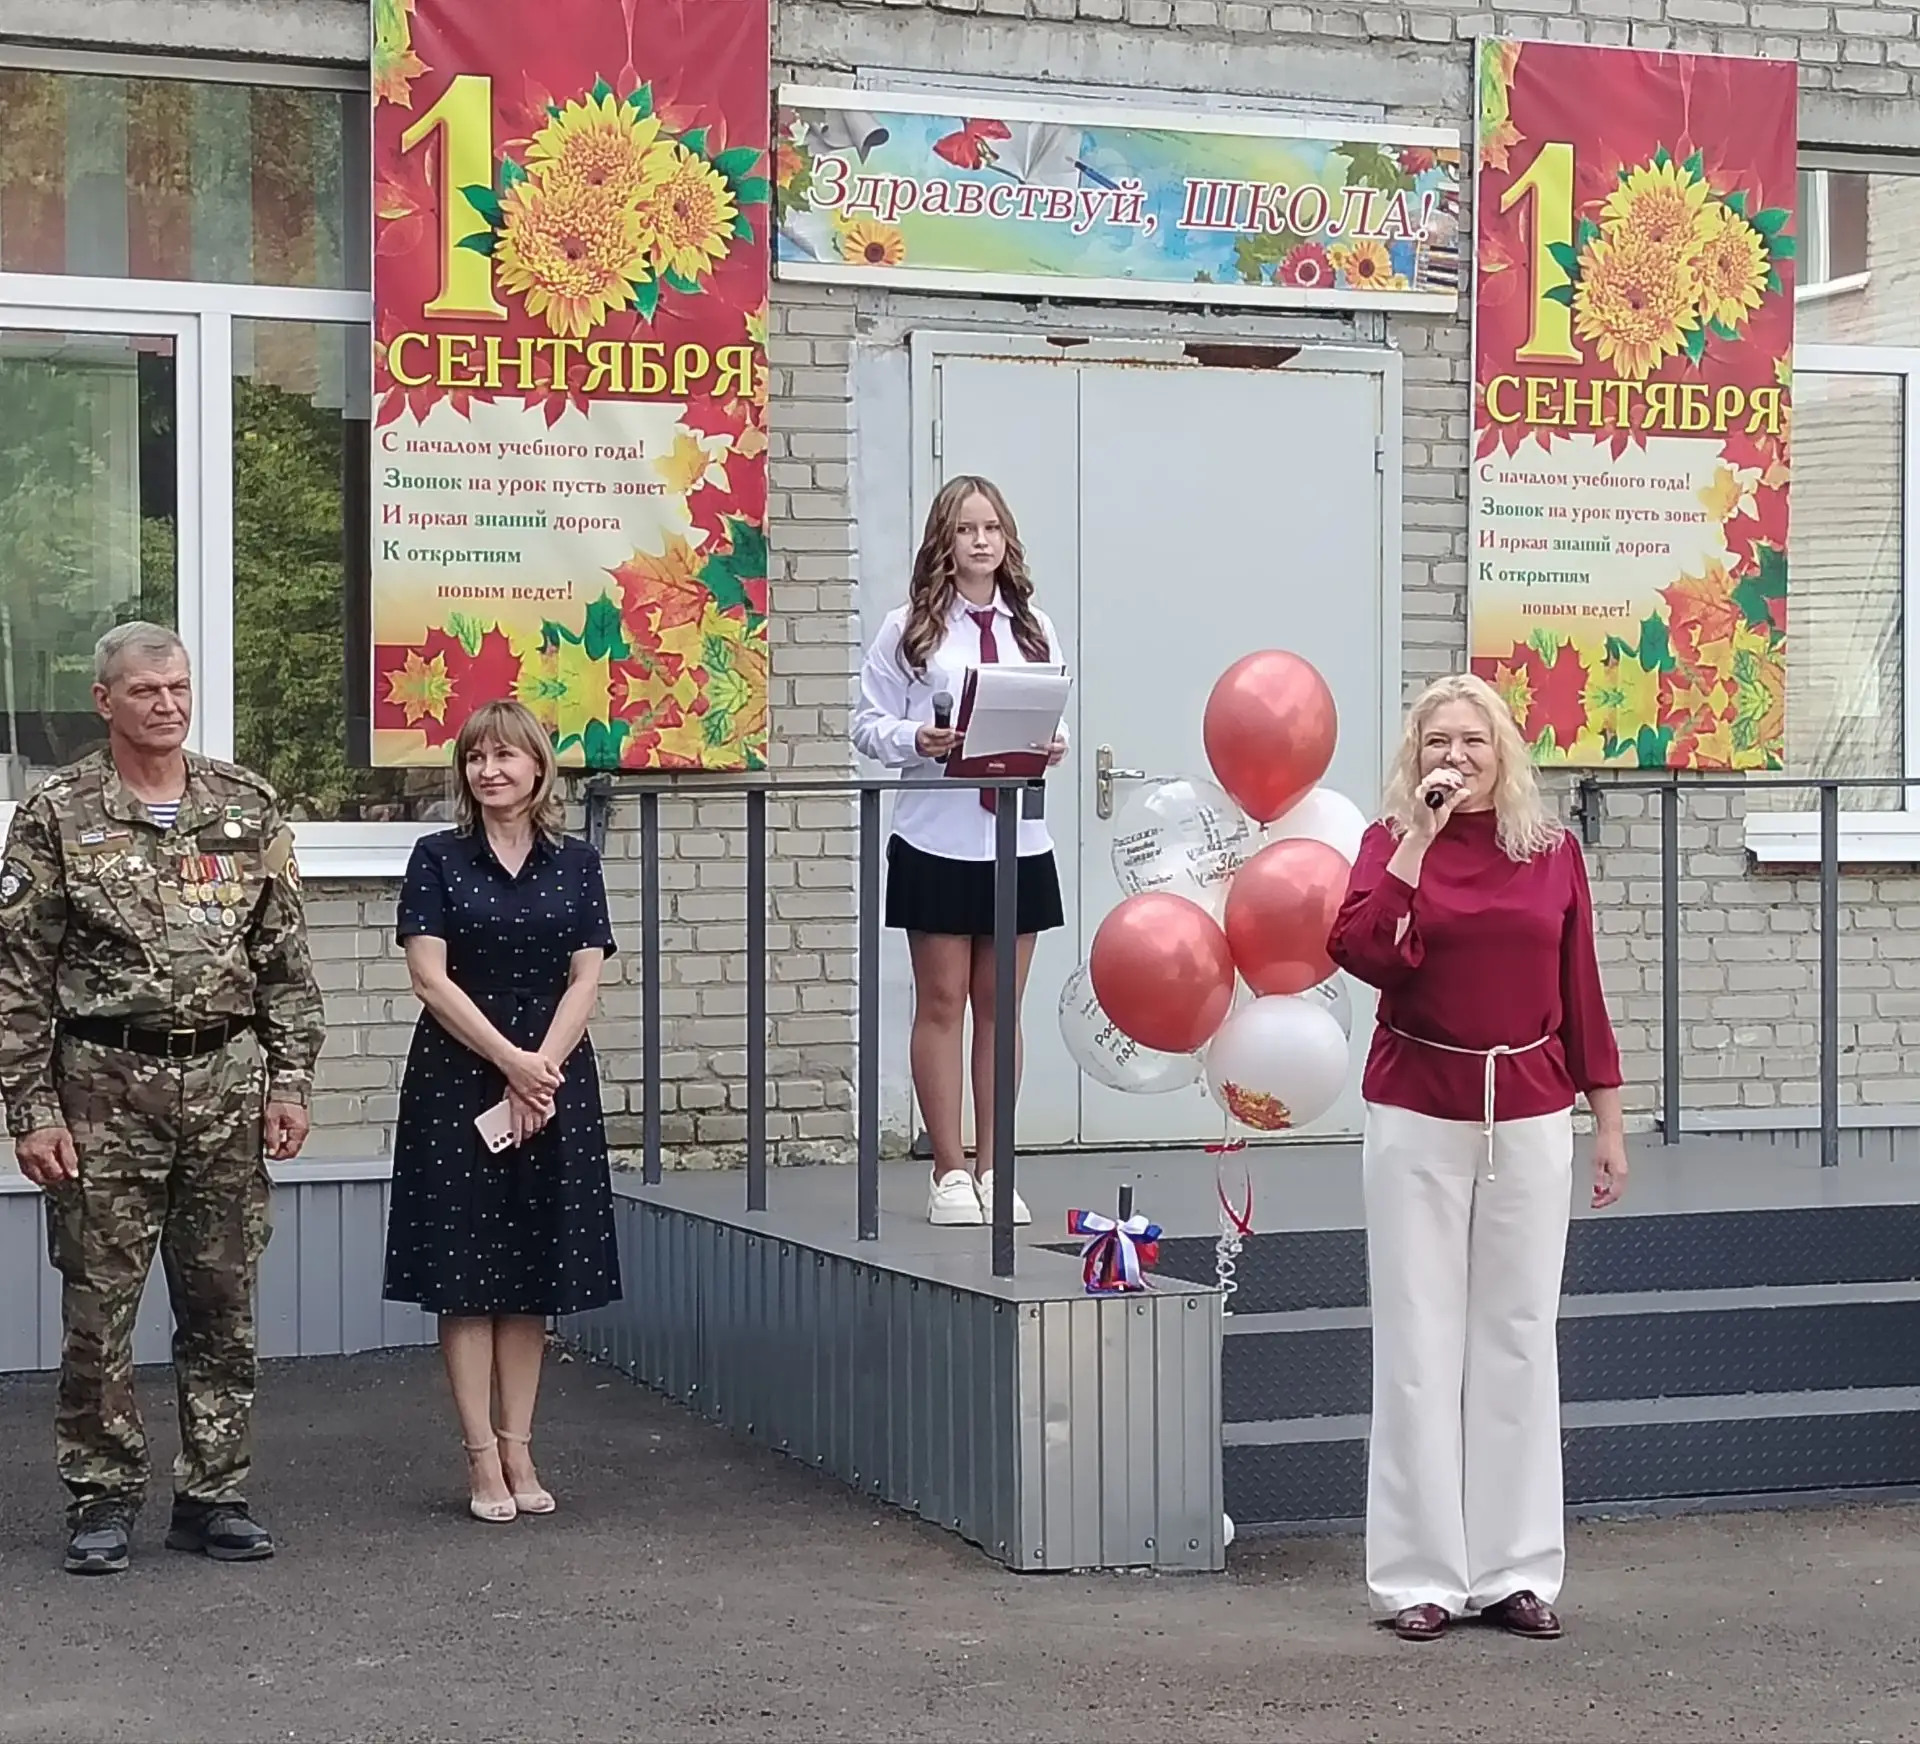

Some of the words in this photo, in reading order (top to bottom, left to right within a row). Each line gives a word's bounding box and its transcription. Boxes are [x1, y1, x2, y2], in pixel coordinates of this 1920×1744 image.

[401, 74, 508, 321] 1
[809, 156, 1157, 234] Здравствуй,
[1181, 180, 1436, 241] ШКОЛА!
[1500, 142, 1584, 364] 1
[388, 331, 754, 397] СЕНТЯБРЯ
[1486, 374, 1782, 434] СЕНТЯБРЯ
[381, 431, 398, 452] С
[406, 440, 491, 455] началом
[498, 439, 588, 460] учебного
[594, 440, 644, 459] года!
[383, 467, 462, 490] Звонок
[468, 477, 491, 490] на
[498, 478, 546, 495] урок
[552, 480, 606, 497] пусть
[612, 481, 666, 496] зовет
[1480, 464, 1494, 482] С
[1499, 471, 1568, 485] началом
[1572, 472, 1645, 490] учебного
[1650, 473, 1691, 491] года!
[381, 504, 401, 524] И
[408, 511, 468, 530] яркая
[474, 509, 547, 528] знаний
[553, 515, 621, 533] дорога
[1481, 497, 1544, 518] Звонок
[1549, 506, 1568, 518] на
[1572, 507, 1610, 523] урок
[1615, 508, 1660, 524] пусть
[1664, 511, 1707, 523] зовет
[382, 540, 399, 561] К
[407, 548, 521, 566] открытиям
[1479, 530, 1495, 548] И
[1500, 537, 1548, 552] яркая
[1553, 536, 1611, 552] знаний
[1615, 541, 1670, 558] дорога
[1479, 562, 1493, 581] К
[1499, 569, 1590, 586] открытиям
[437, 583, 505, 598] новым
[511, 580, 573, 601] ведет!
[1522, 602, 1577, 616] новым
[1582, 600, 1631, 618] ведет!
